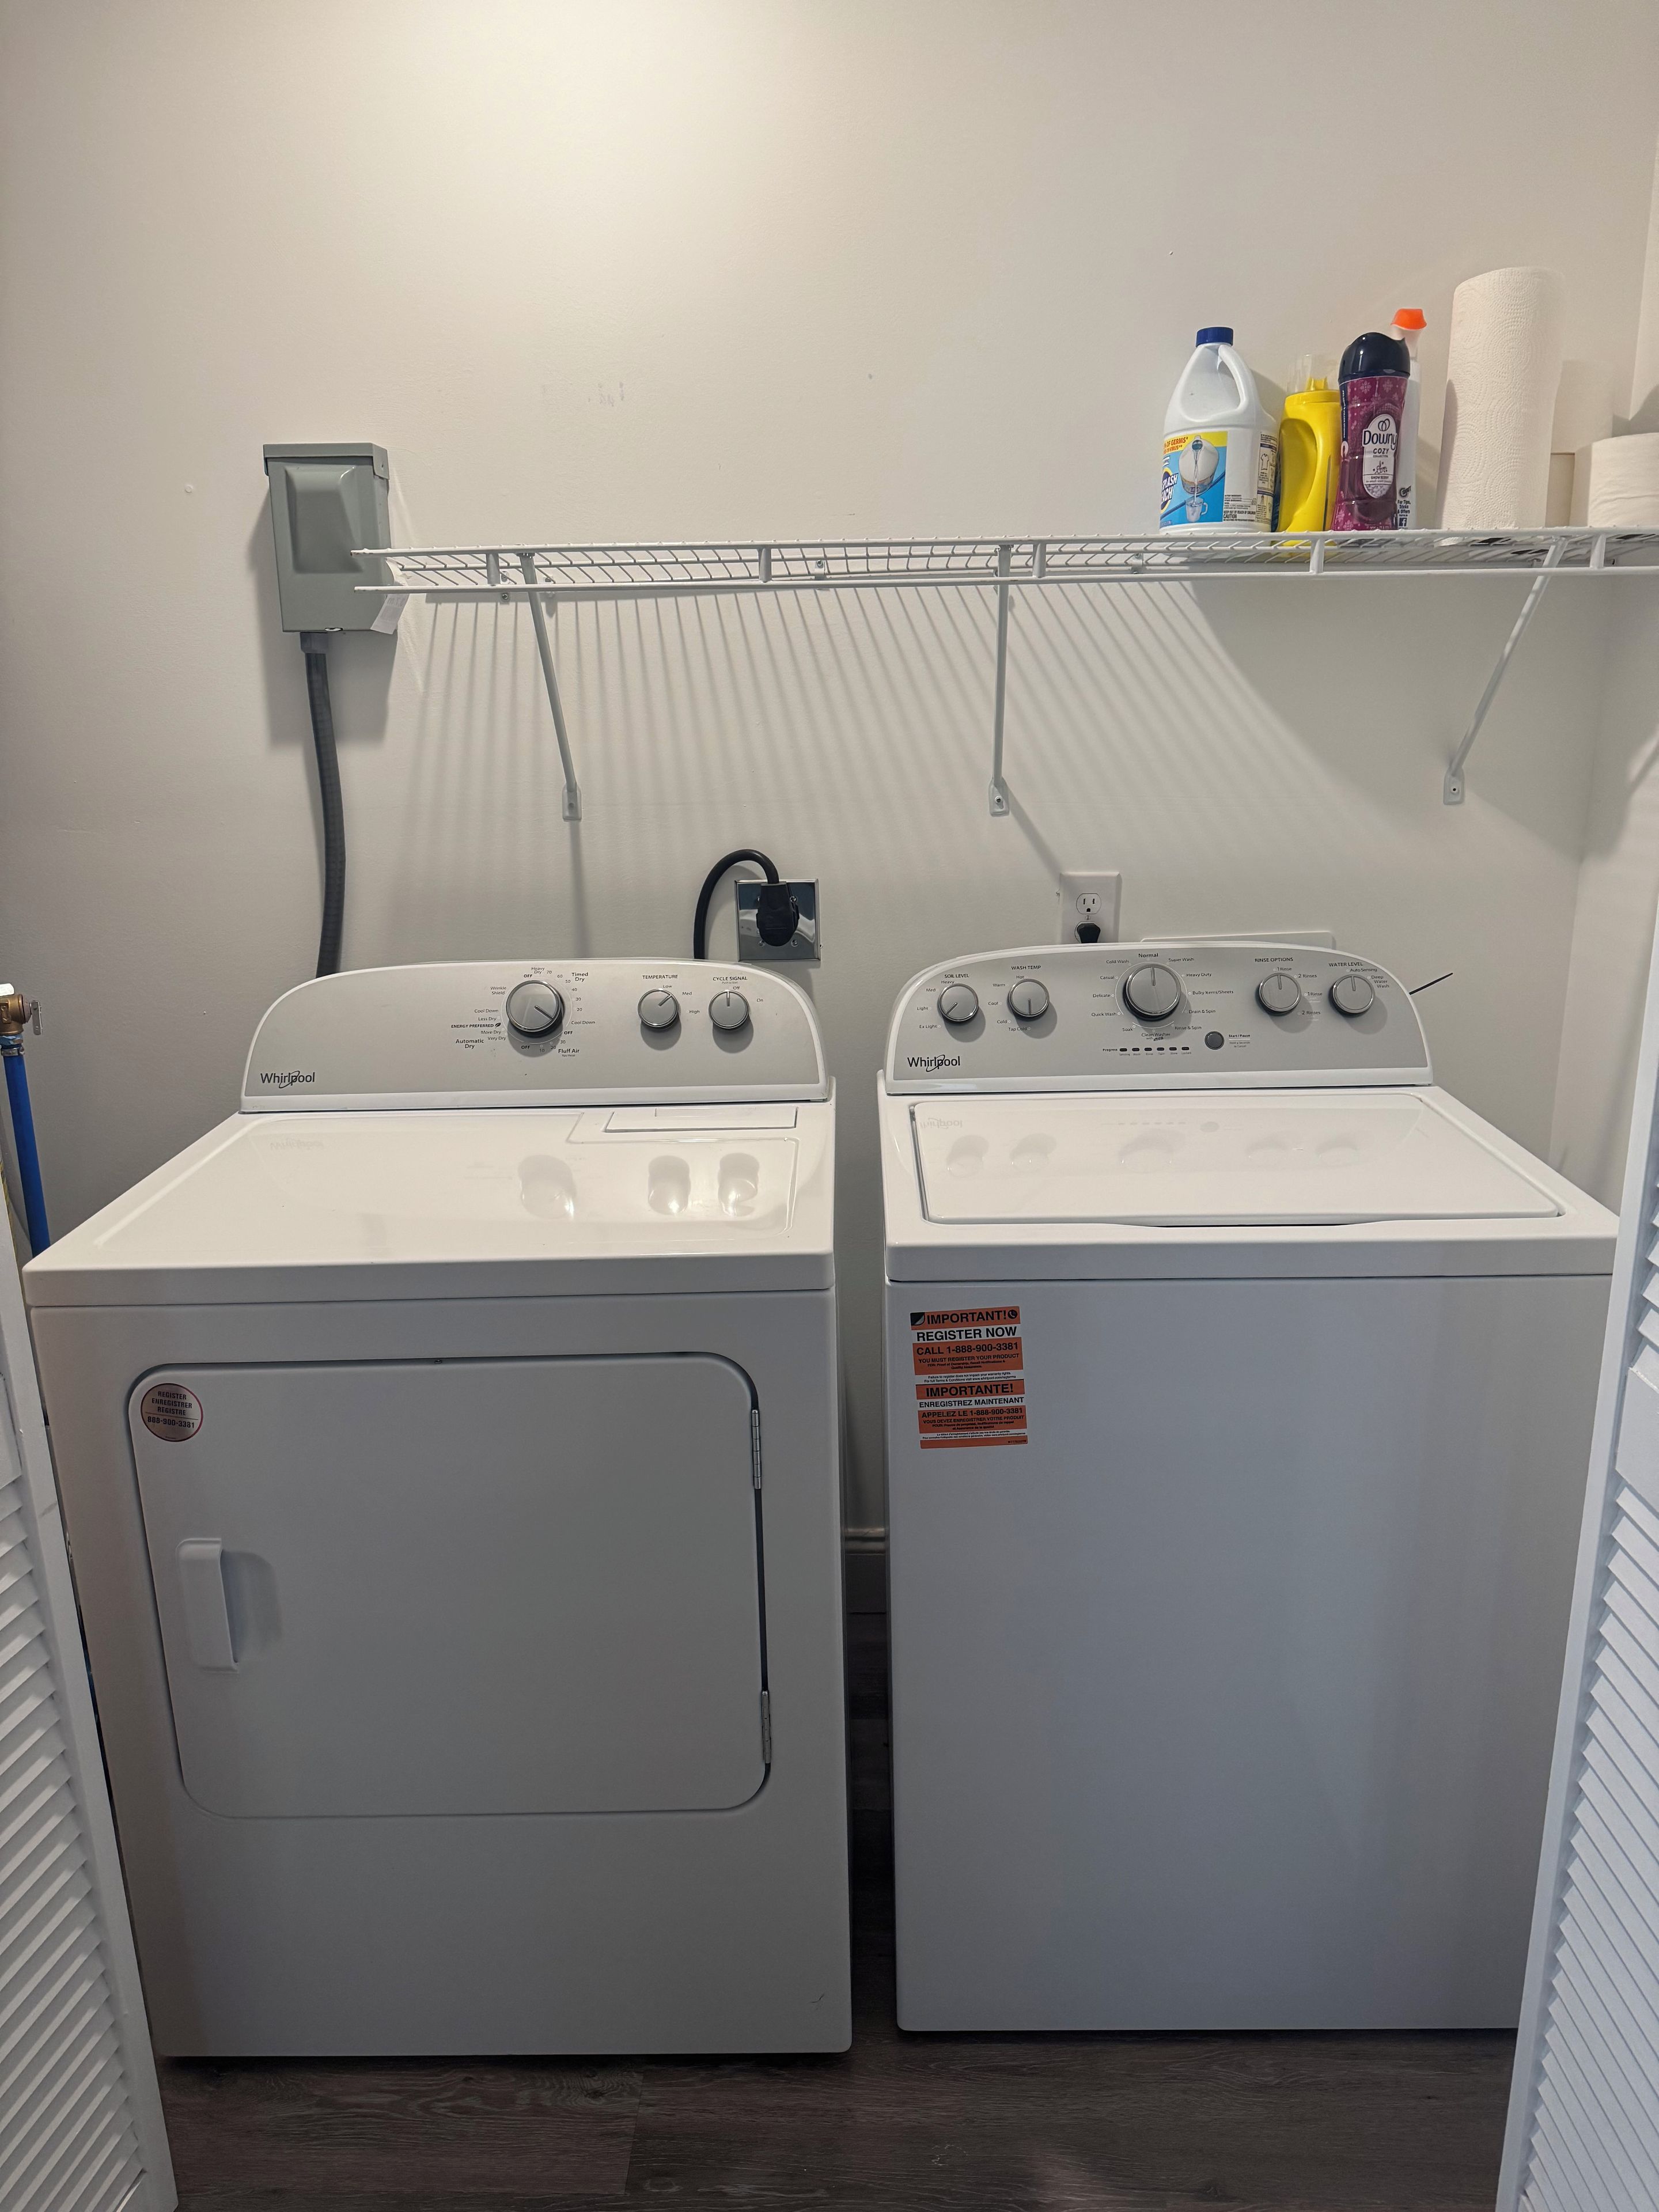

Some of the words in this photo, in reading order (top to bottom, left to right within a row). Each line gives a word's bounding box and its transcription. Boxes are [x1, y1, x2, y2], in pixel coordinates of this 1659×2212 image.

[1363, 430, 1397, 450] Downy
[907, 1055, 960, 1072] Whirlpool
[260, 1071, 315, 1089] Whirlpool
[927, 1310, 1006, 1324] IMPORTANT!
[916, 1328, 982, 1342] REGISTER
[986, 1327, 1017, 1338] NOW
[916, 1346, 944, 1355] CALL
[946, 1342, 1018, 1354] 1-888-900-3381
[158, 1391, 187, 1400] REGISTER
[926, 1384, 1013, 1397] IMPORTANTE!
[151, 1398, 192, 1408] ENREGISTRER
[919, 1400, 972, 1408] ENREGISTREZ
[975, 1397, 1024, 1406] MAINTENANT
[157, 1406, 186, 1415] REGISTRE
[970, 1408, 1023, 1416] 1-888-900-3381
[147, 1416, 195, 1429] 888-900-3381
